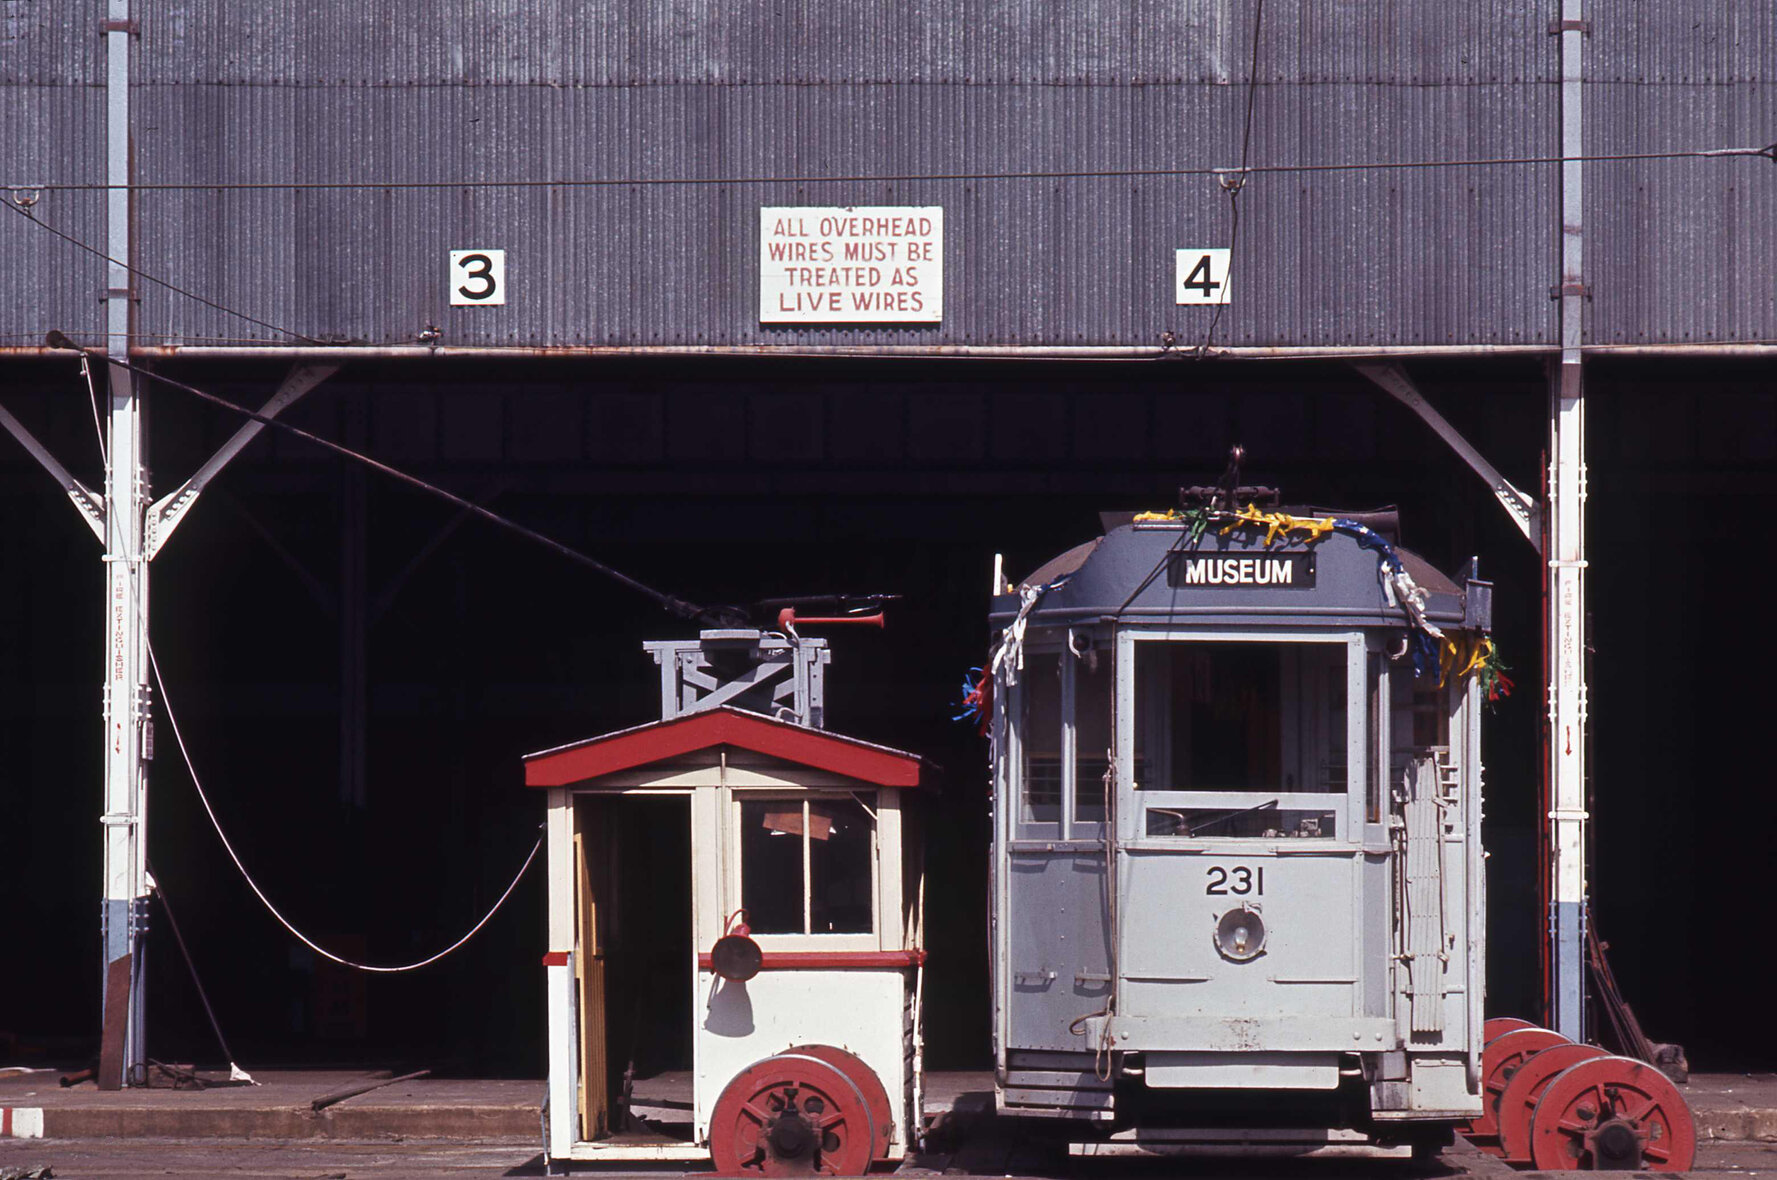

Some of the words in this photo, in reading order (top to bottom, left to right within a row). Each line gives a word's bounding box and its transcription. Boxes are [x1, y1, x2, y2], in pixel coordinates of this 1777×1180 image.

[774, 218, 809, 237] ALL
[819, 217, 932, 237] OVERHEAD
[768, 241, 834, 262] WIRES
[844, 242, 898, 262] MUST
[907, 242, 933, 262] BE
[458, 253, 496, 300] 3
[784, 267, 881, 287] TREATED
[891, 267, 919, 287] AS
[1183, 255, 1220, 297] 4
[779, 292, 842, 312] LIVE
[851, 291, 923, 312] WIRES
[1185, 559, 1293, 584] MUSEUM
[115, 605, 124, 681] EXTINGUISHER
[1206, 866, 1263, 895] 231
